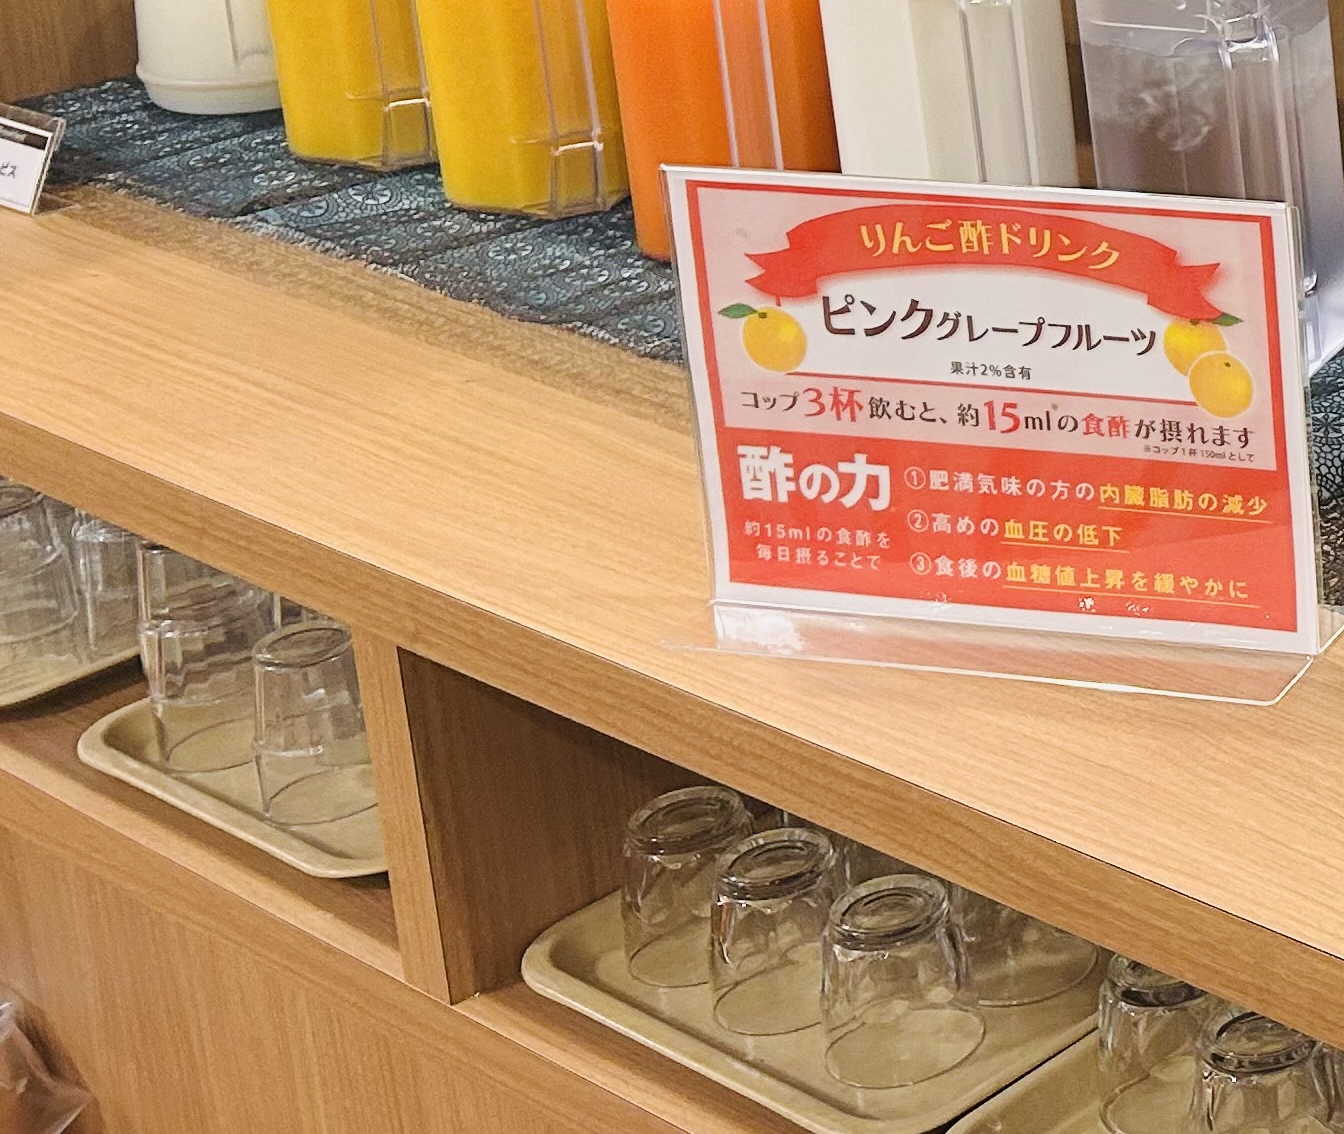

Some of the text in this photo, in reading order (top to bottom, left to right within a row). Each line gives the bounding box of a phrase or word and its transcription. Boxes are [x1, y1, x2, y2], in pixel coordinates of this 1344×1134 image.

[860, 219, 1121, 270] りんご酢ドリンク
[822, 293, 1157, 356] ピンクグレープフルーツ
[950, 360, 1032, 381] 果汁2%含有
[736, 444, 891, 512] 酢の力
[744, 520, 892, 550] 約15mlの食酢を
[756, 543, 882, 571] 毎日摂ることで
